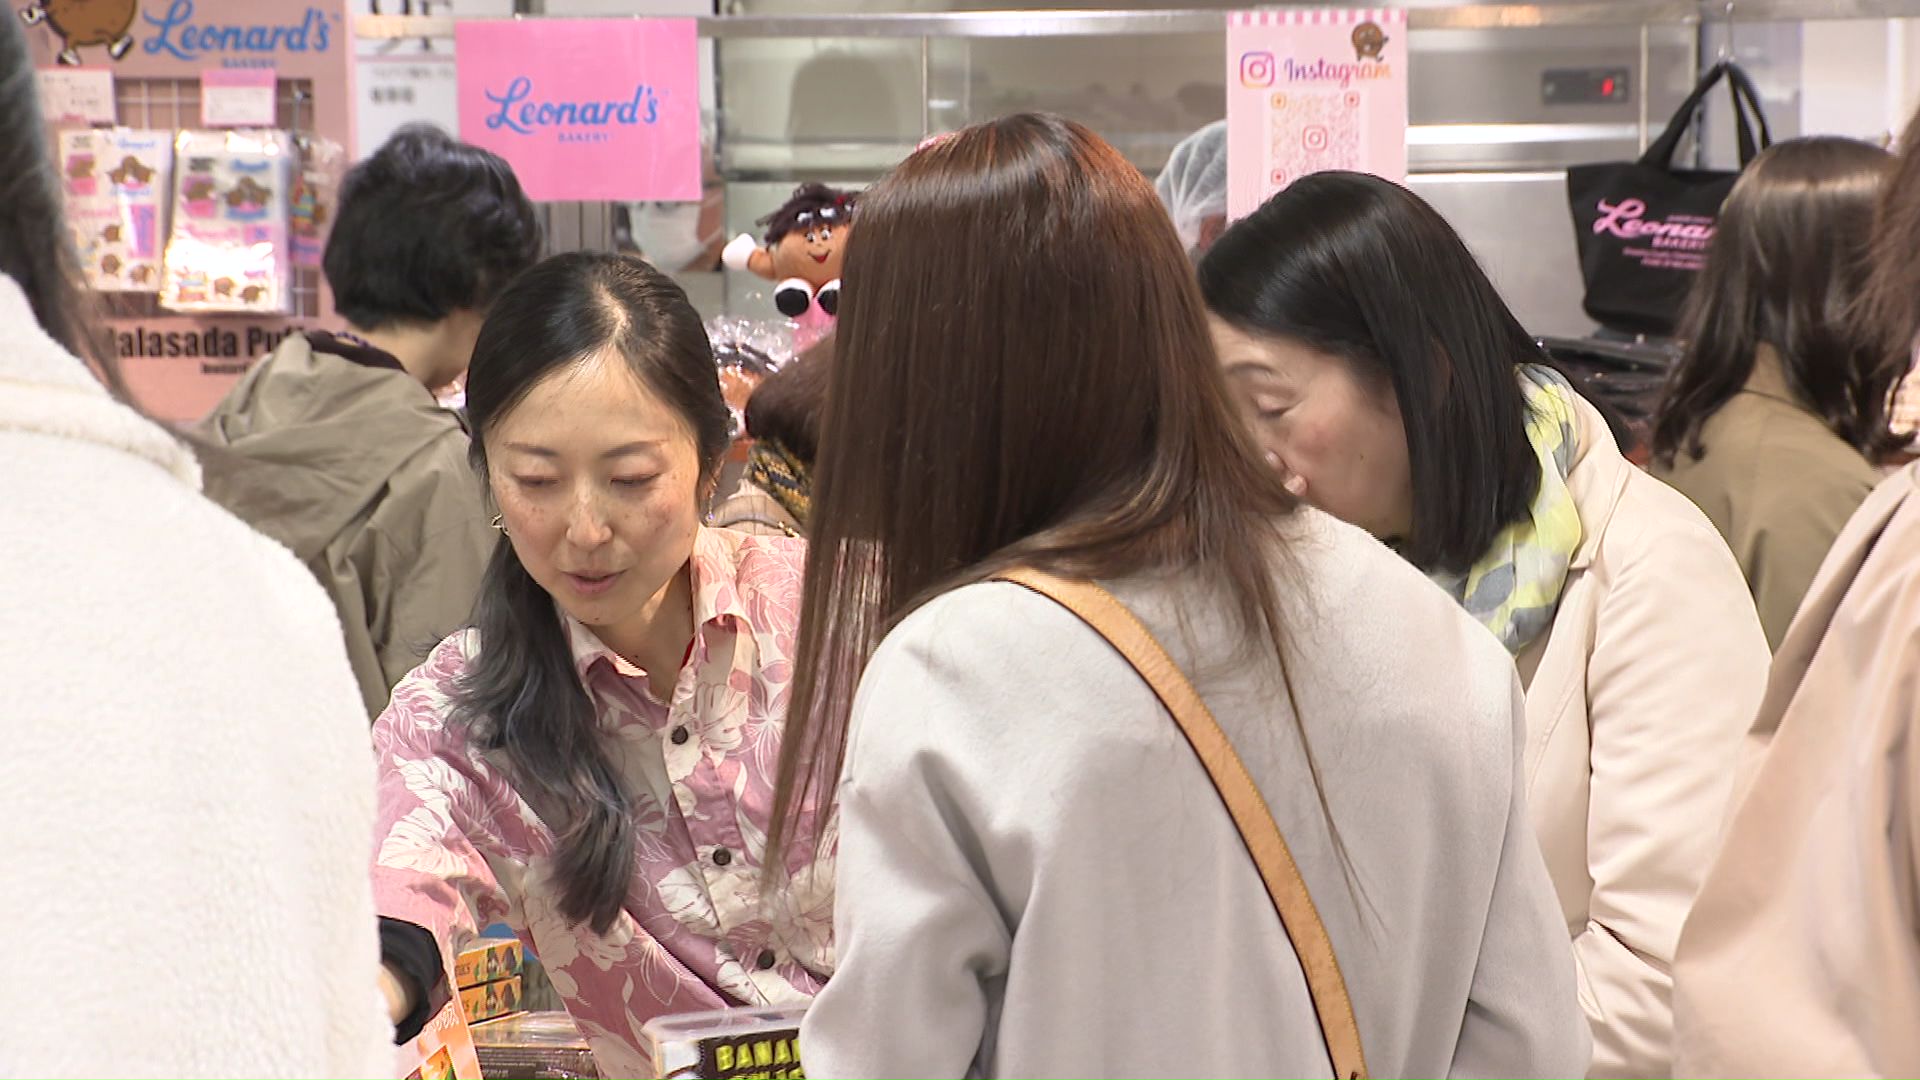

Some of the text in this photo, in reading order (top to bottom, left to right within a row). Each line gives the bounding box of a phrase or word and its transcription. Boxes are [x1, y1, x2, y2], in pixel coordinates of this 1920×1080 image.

[141, 0, 329, 61] Leonard's
[1283, 57, 1392, 90] Instagram
[484, 76, 658, 134] Leonard's
[557, 133, 608, 142] BAKERY
